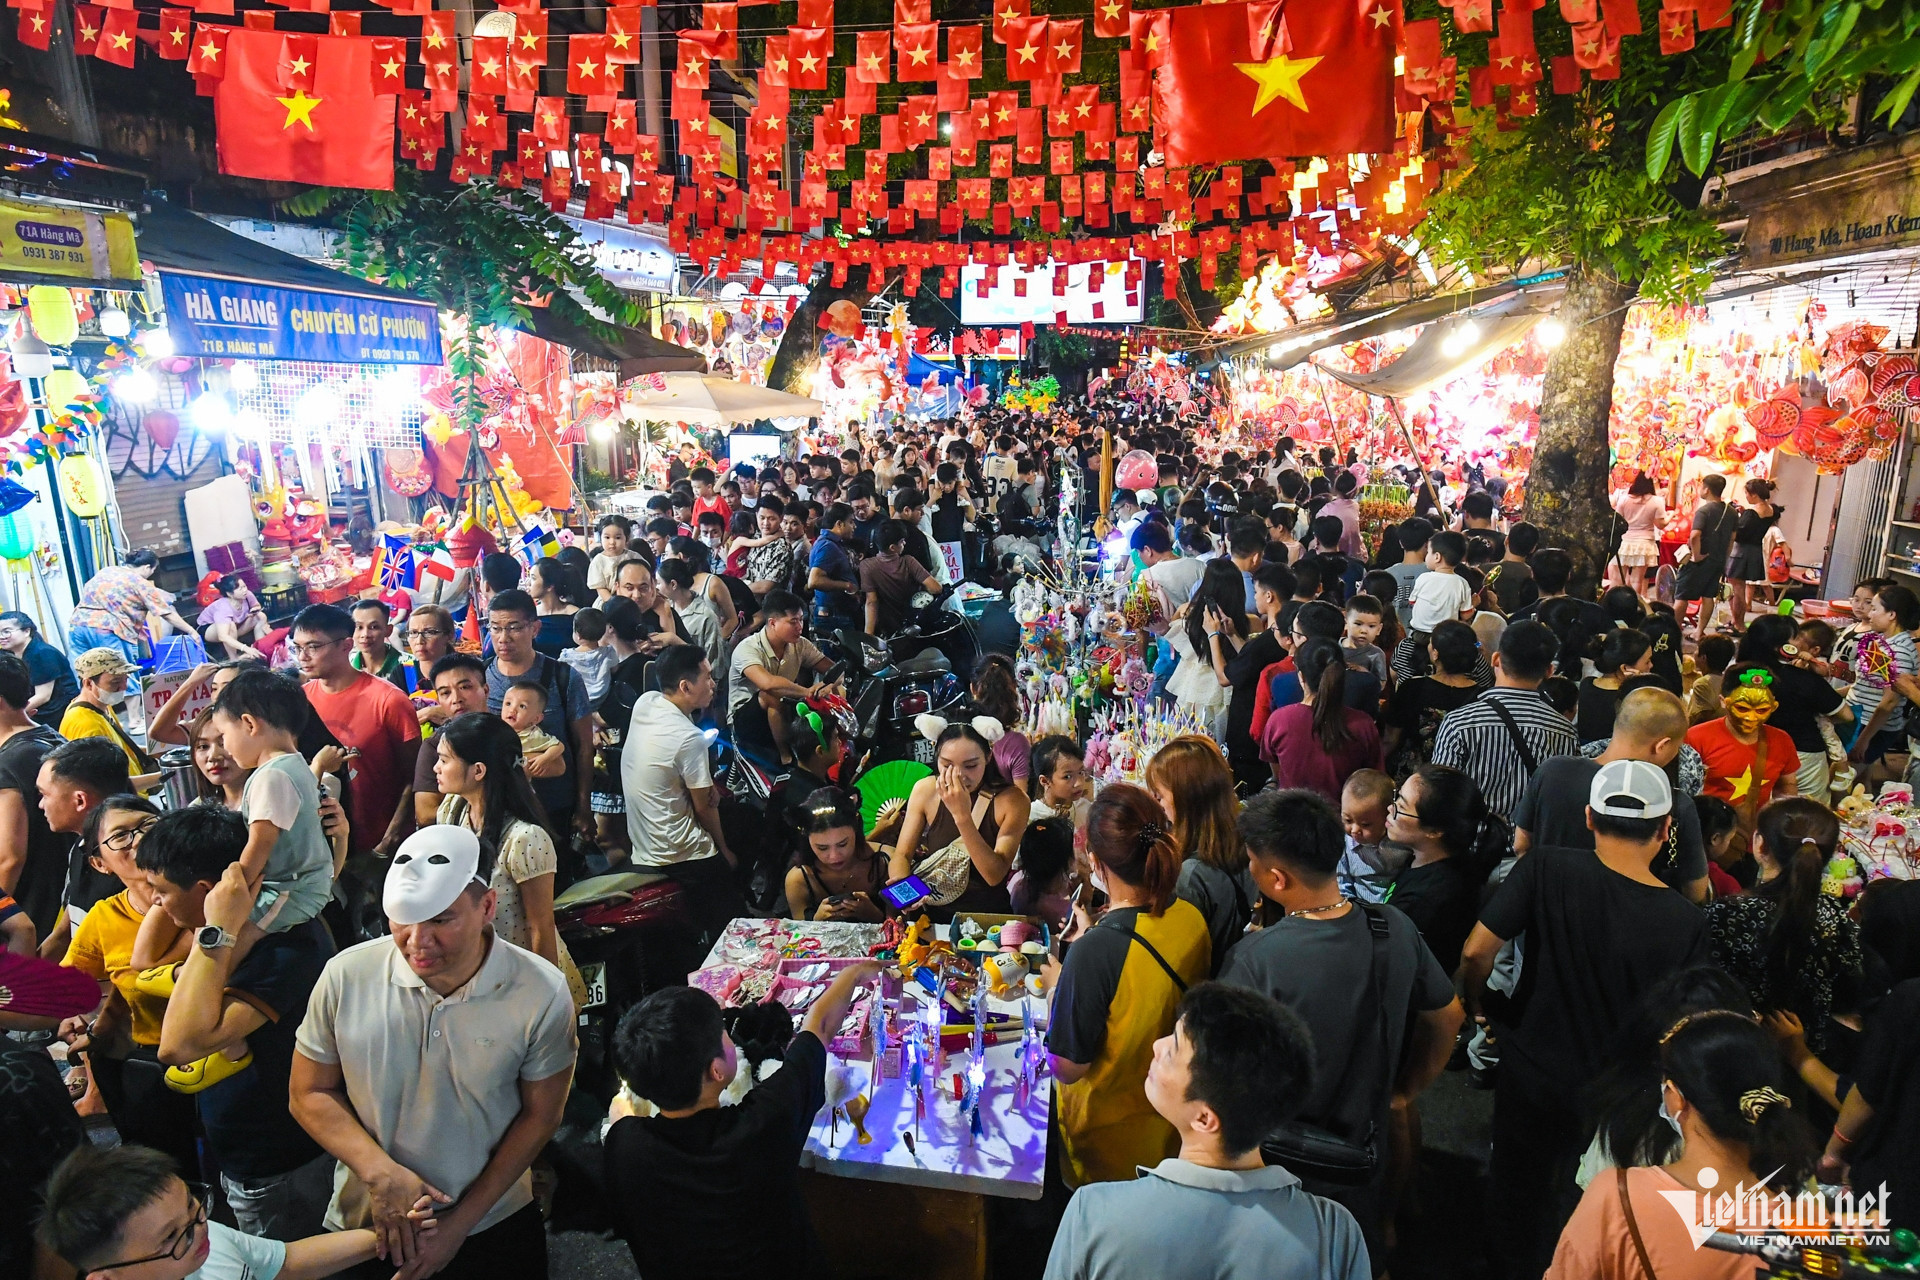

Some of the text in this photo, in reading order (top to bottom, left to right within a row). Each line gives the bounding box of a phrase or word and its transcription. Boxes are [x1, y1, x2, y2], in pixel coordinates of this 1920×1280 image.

[19, 225, 81, 243] 71A Hàng Mã
[1785, 235, 1816, 254] Hang
[1818, 227, 1842, 247] Ma,
[1845, 222, 1882, 243] Hoan
[22, 246, 85, 262] 0931 387 931
[185, 288, 279, 326] HÀ GIANG
[290, 308, 427, 340] CHUYÊN CỜ PHƯỚN
[202, 339, 276, 355] 71B HÀNG MÃ
